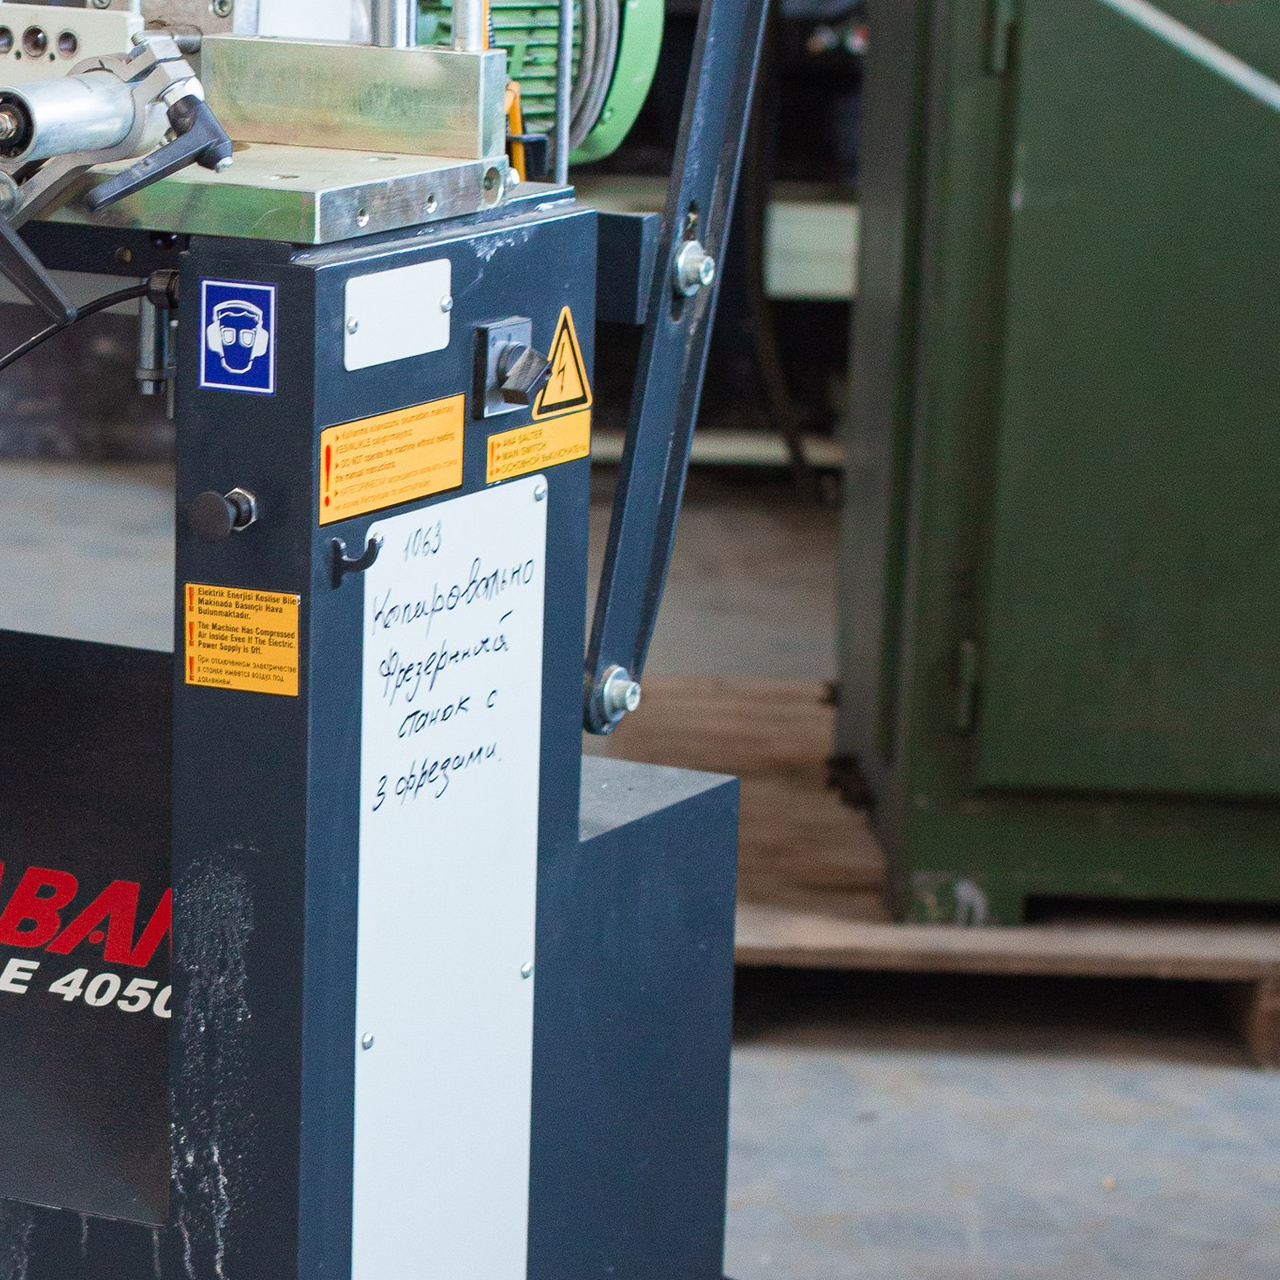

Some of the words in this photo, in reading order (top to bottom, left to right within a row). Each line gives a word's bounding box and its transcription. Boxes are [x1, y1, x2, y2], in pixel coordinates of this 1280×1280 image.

[502, 448, 518, 460] MAIN
[521, 441, 546, 455] SWITCH
[351, 454, 362, 465] NOT
[404, 520, 442, 562] 1063
[198, 587, 225, 598] Elektrik
[228, 590, 254, 602] Enerjisi
[198, 596, 233, 608] Makinada
[266, 604, 284, 613] Hava
[198, 621, 210, 629] The
[212, 622, 239, 632] Machine
[242, 625, 254, 634] Has
[256, 627, 296, 640] Compressed
[198, 630, 207, 638] Air
[210, 631, 229, 640] Inside
[231, 634, 246, 642] Even
[256, 637, 266, 645] The
[198, 640, 218, 649] Power
[220, 642, 241, 653] Supply
[198, 654, 209, 664] При
